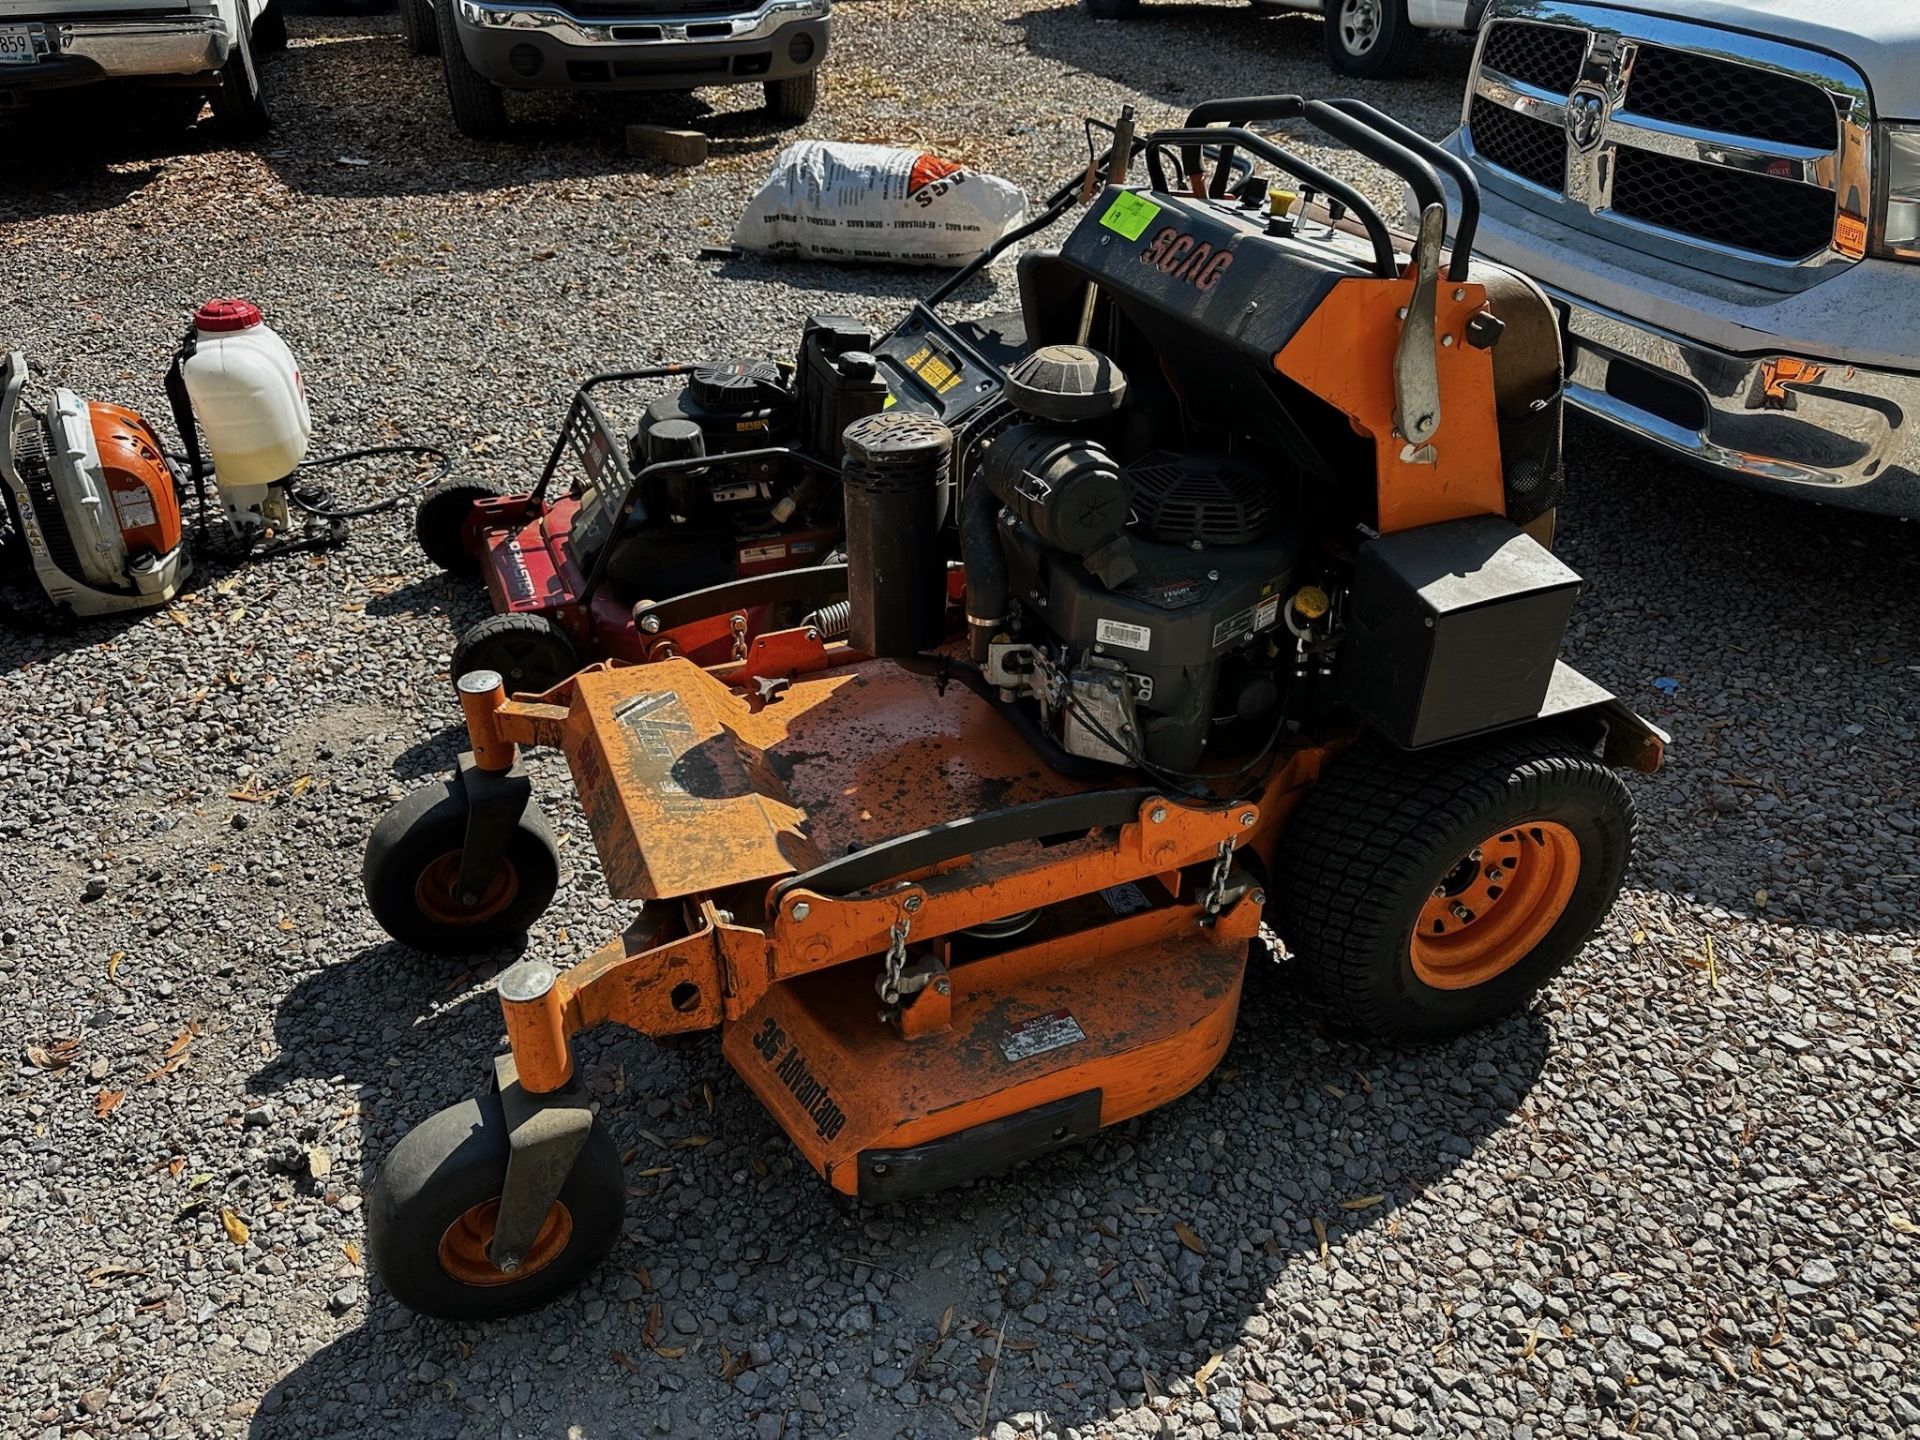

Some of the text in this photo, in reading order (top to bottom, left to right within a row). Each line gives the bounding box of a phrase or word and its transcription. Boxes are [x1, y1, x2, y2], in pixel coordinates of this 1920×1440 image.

[914, 171, 966, 208] AGS
[763, 215, 780, 224] BAGS
[847, 219, 865, 229] BAGS
[865, 220, 883, 229] DEMO
[945, 223, 961, 232] BAGS
[1140, 226, 1233, 290] SCAG
[752, 1017, 847, 1141] 36 Advantage
